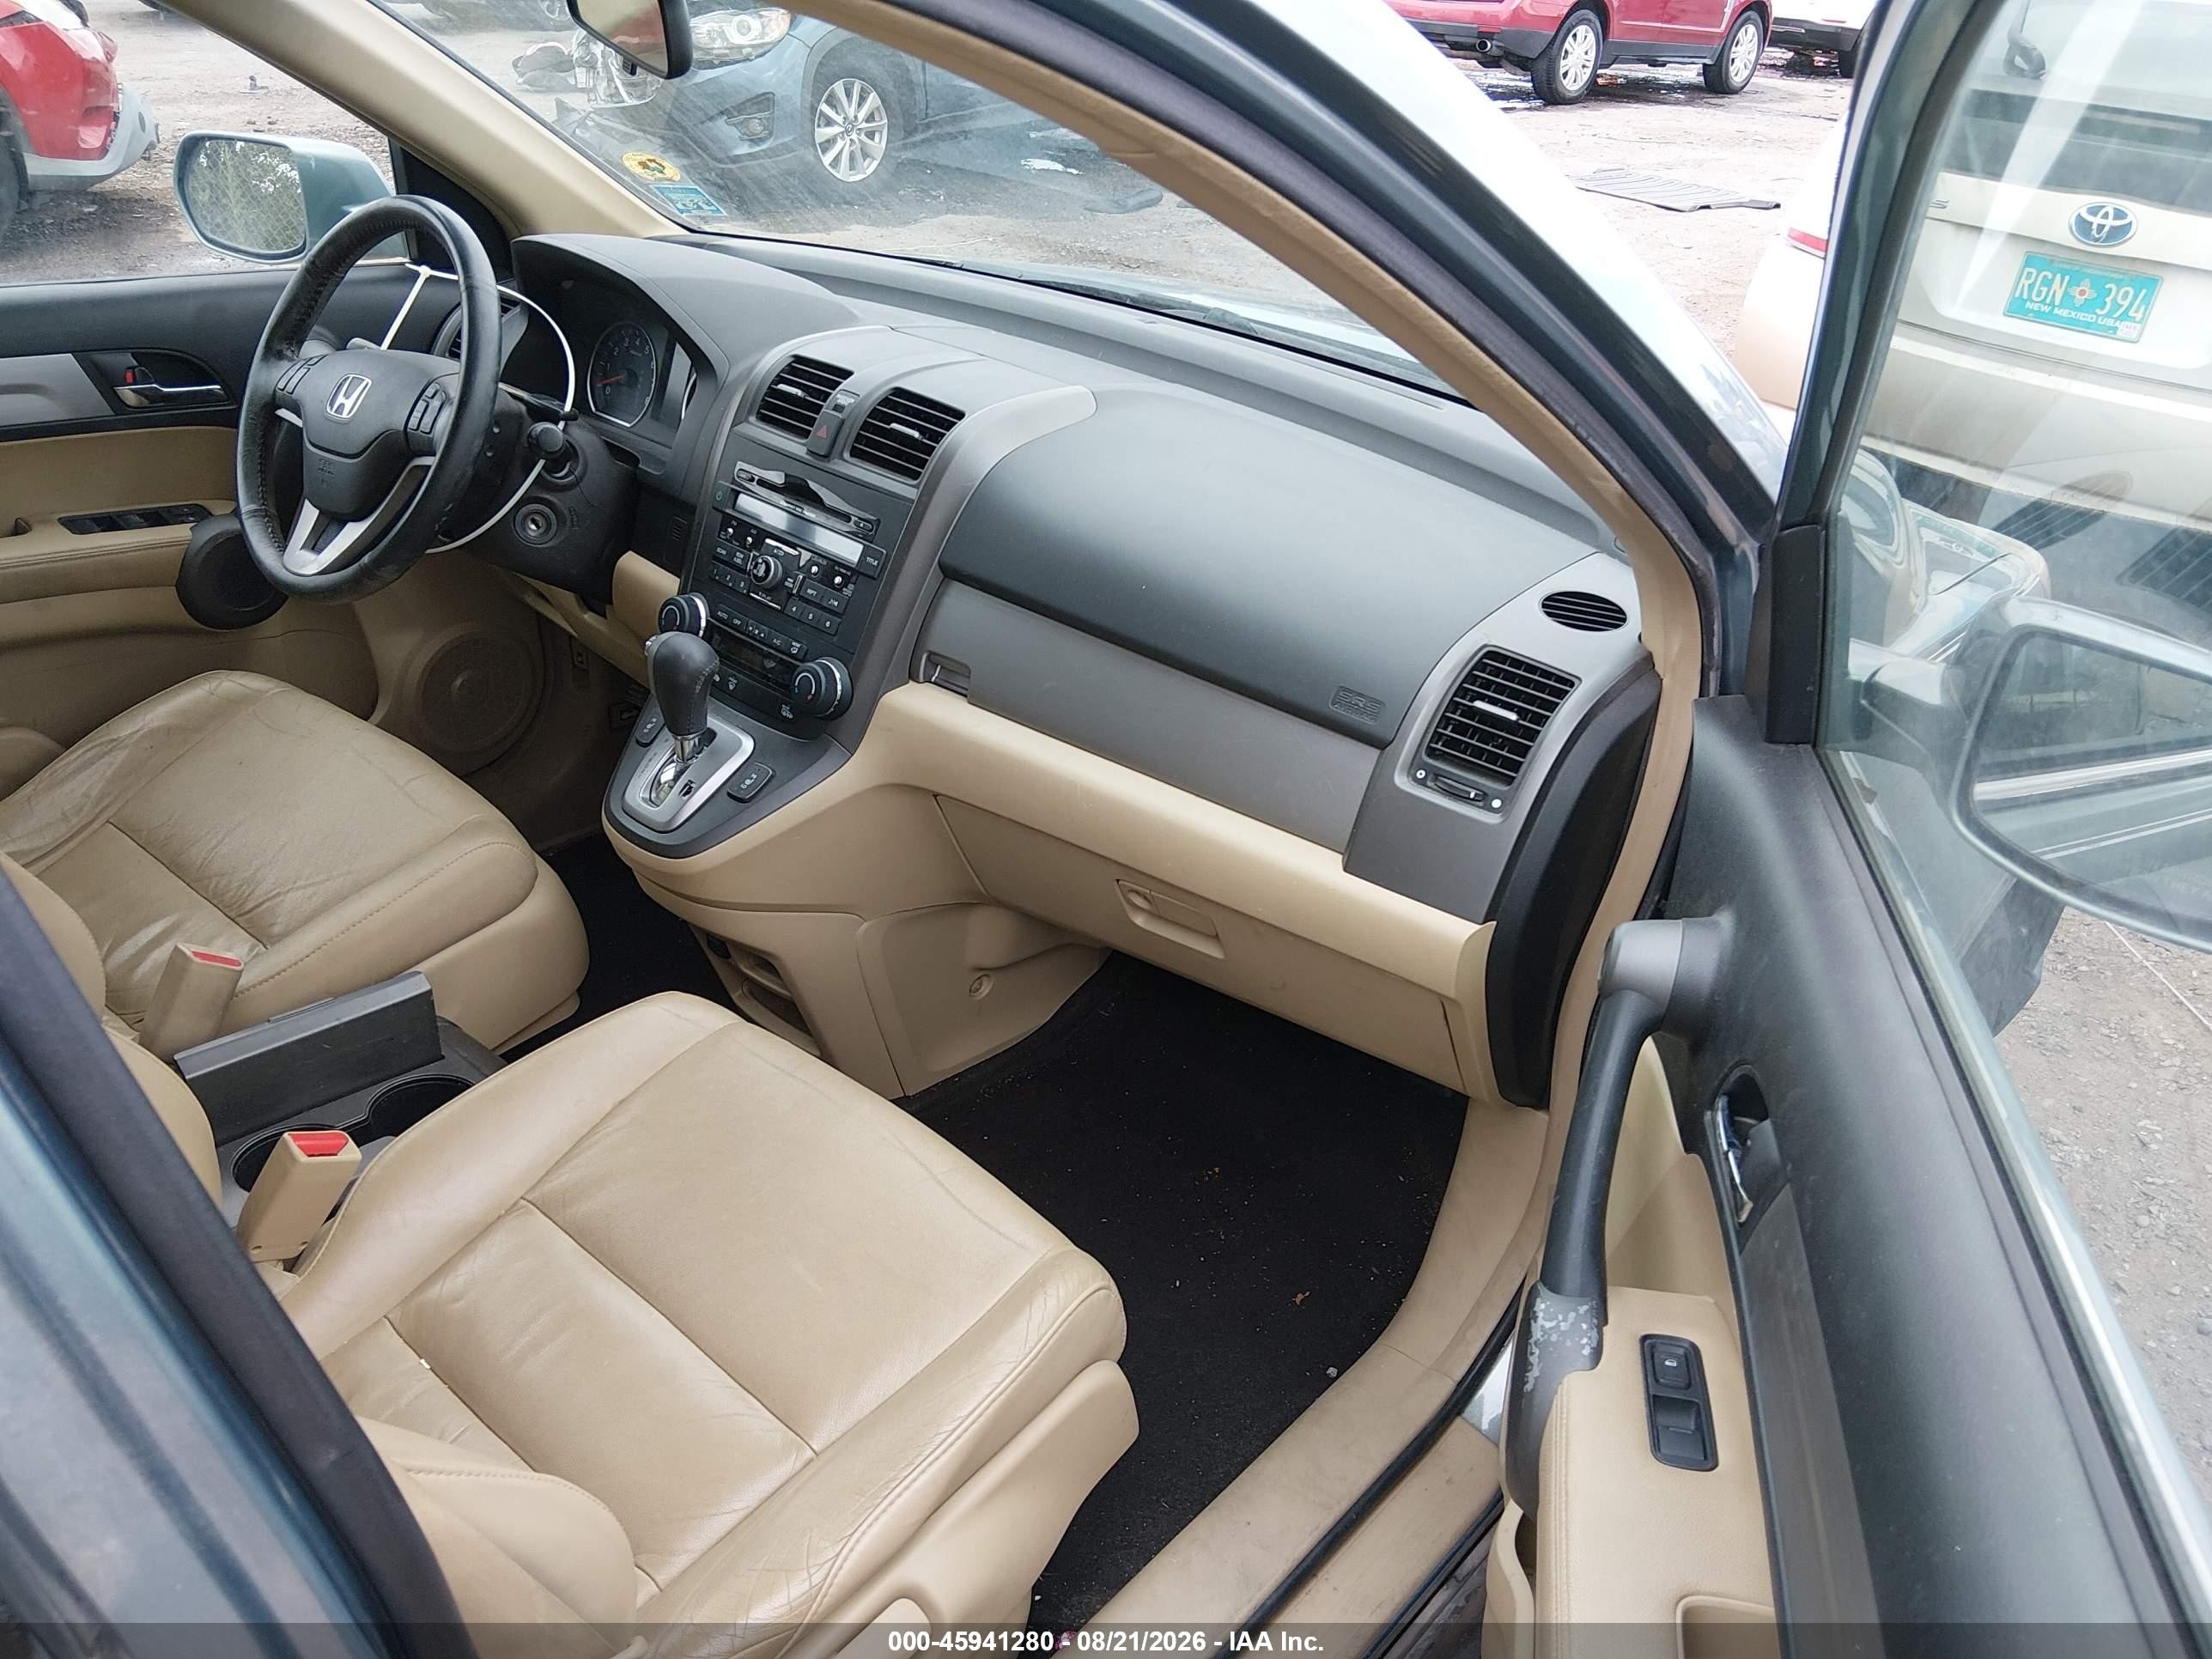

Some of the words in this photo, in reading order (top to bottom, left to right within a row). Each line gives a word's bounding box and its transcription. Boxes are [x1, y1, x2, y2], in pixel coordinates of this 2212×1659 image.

[2014, 267, 2070, 307] RGN
[2095, 283, 2147, 322] 394
[2025, 301, 2051, 313] NEW
[2053, 307, 2097, 322] MEXICO
[866, 556, 878, 567] TITLE
